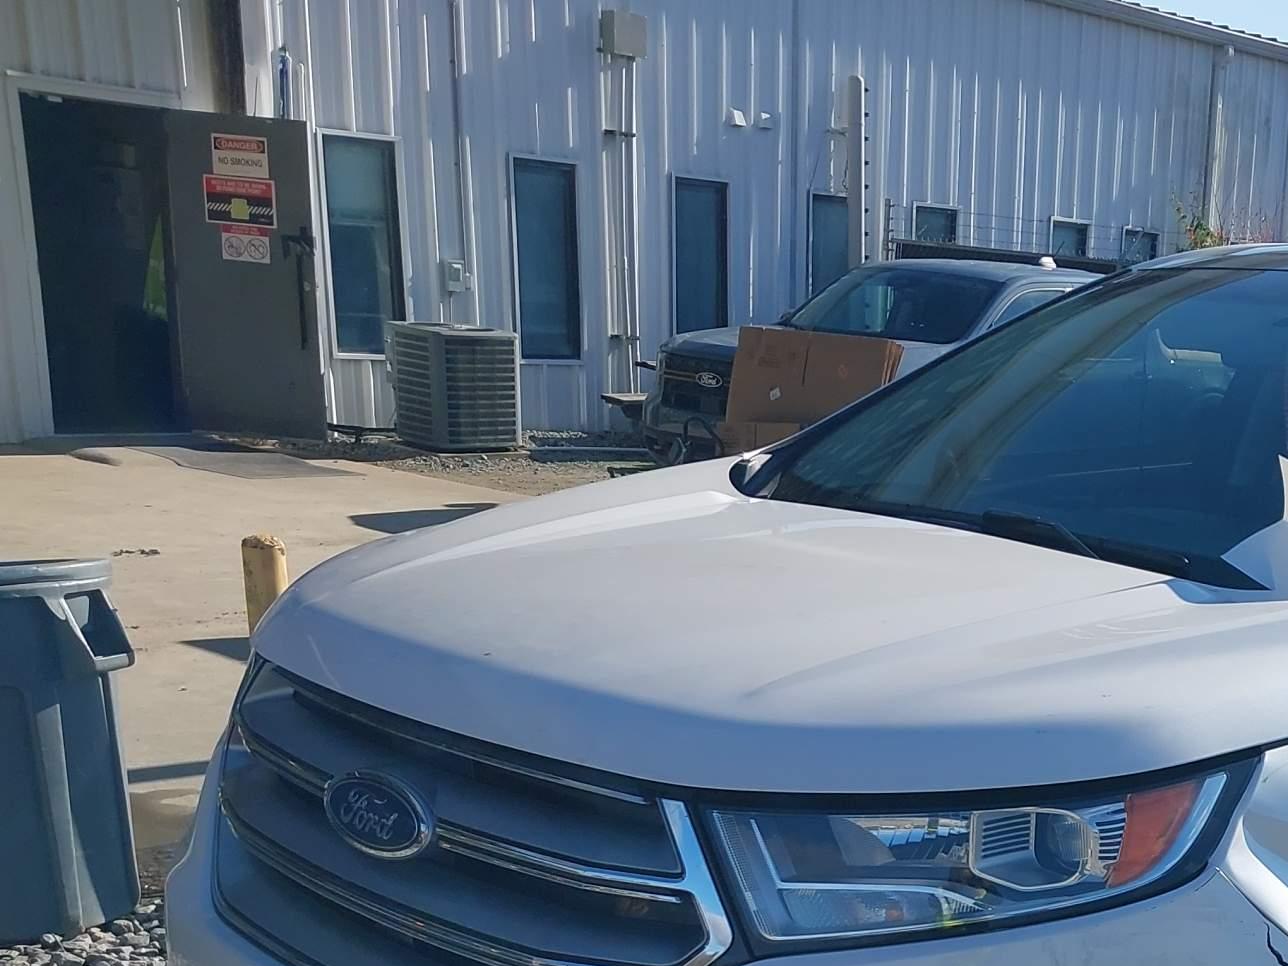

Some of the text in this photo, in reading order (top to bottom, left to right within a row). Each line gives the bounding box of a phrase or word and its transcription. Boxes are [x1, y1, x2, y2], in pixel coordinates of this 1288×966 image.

[219, 140, 259, 152] DANGER
[218, 156, 263, 168] NO SMOKING
[341, 787, 399, 840] Ford
